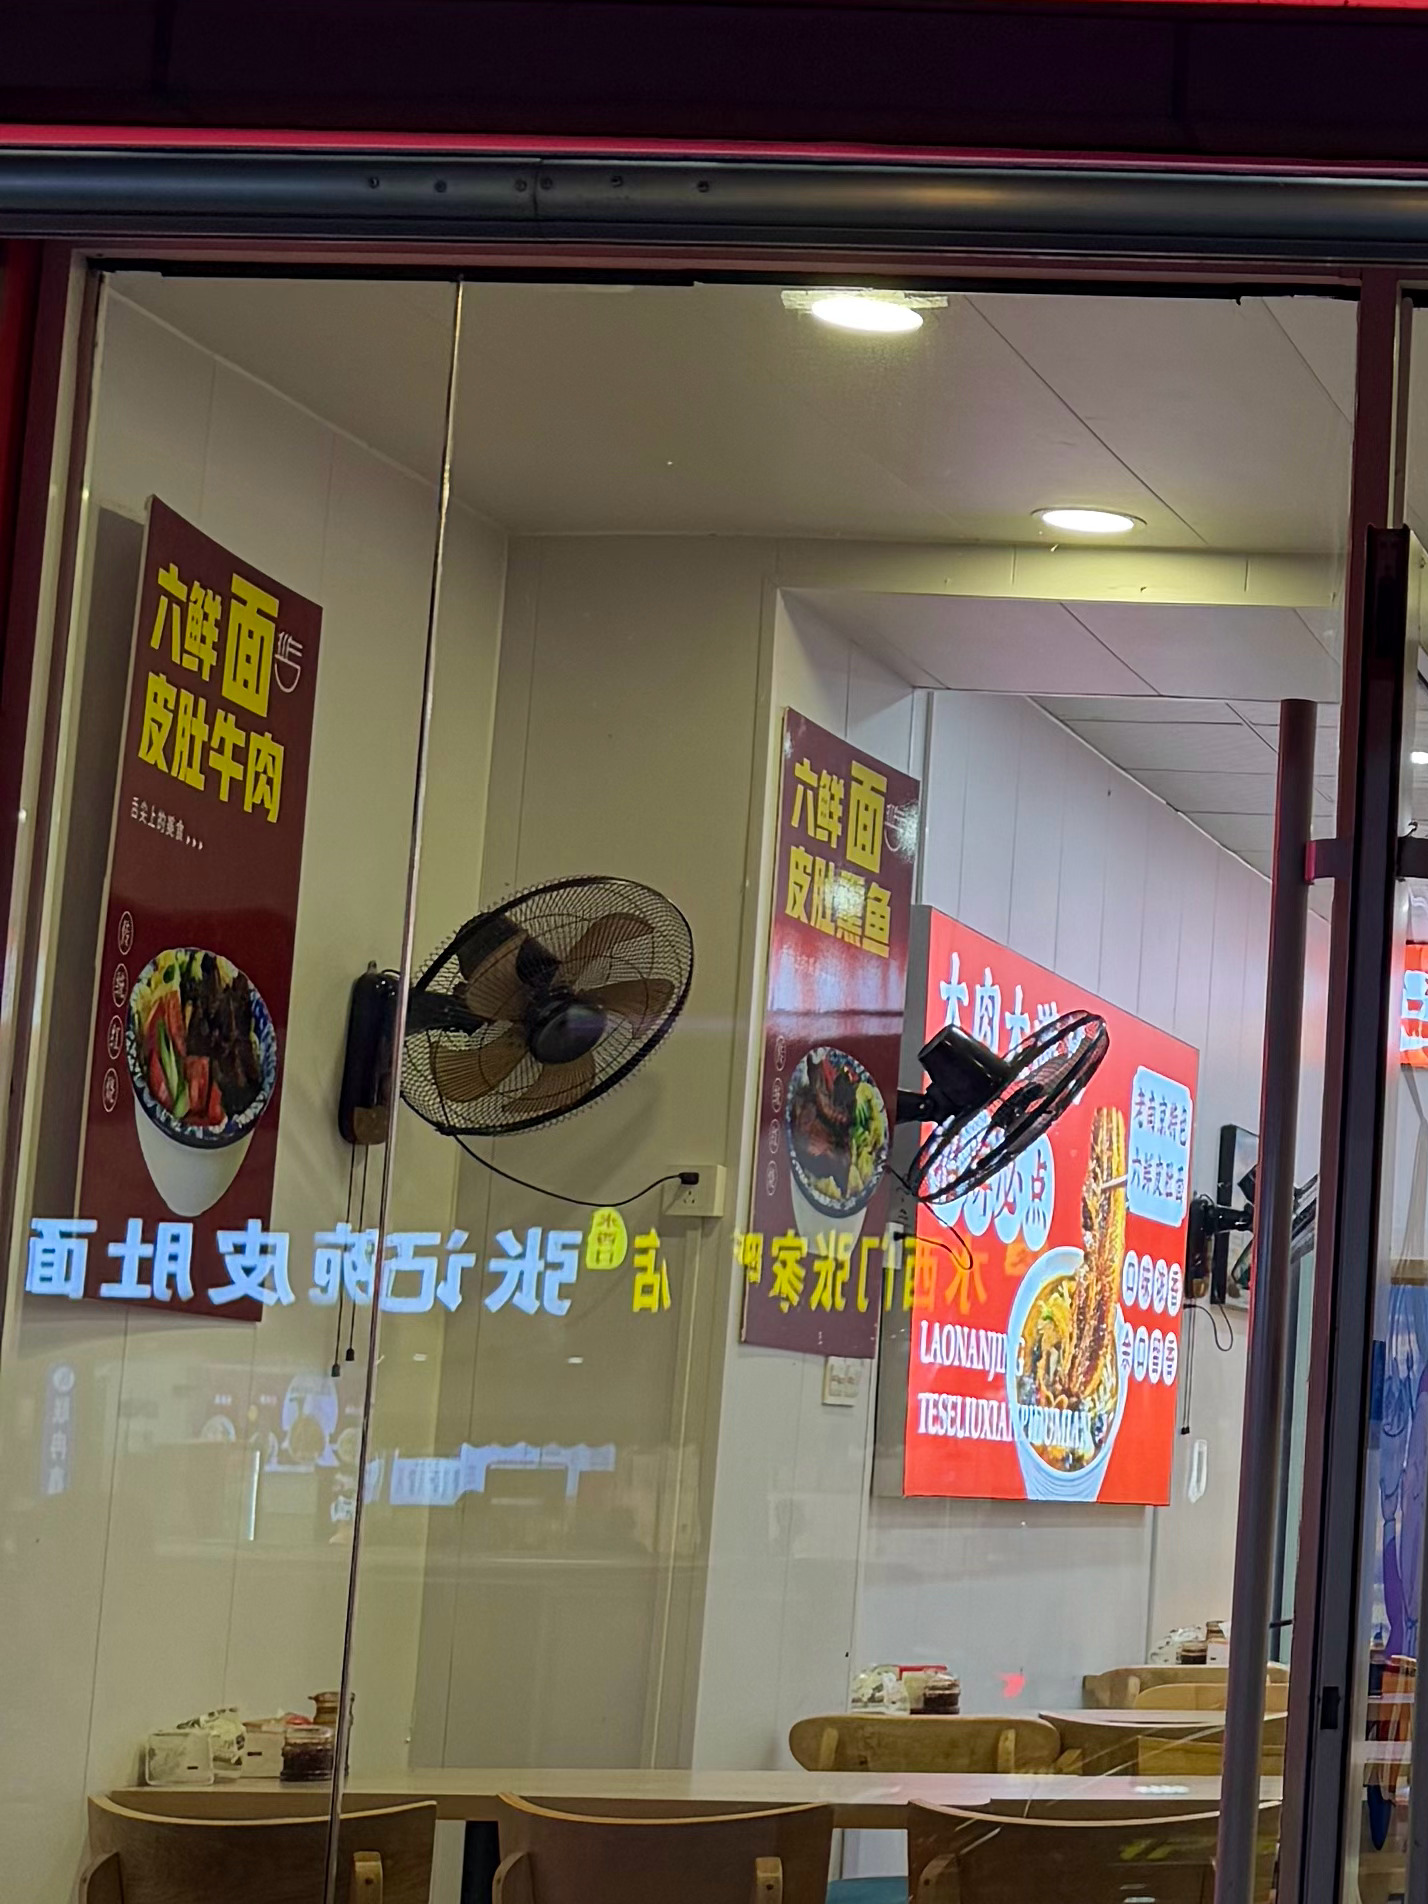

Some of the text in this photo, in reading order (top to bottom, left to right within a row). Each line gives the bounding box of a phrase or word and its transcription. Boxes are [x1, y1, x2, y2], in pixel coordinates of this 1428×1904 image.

[152, 561, 279, 718] 六鲜面
[137, 671, 285, 824] 皮肚牛肉
[790, 757, 888, 874] 六鲜面
